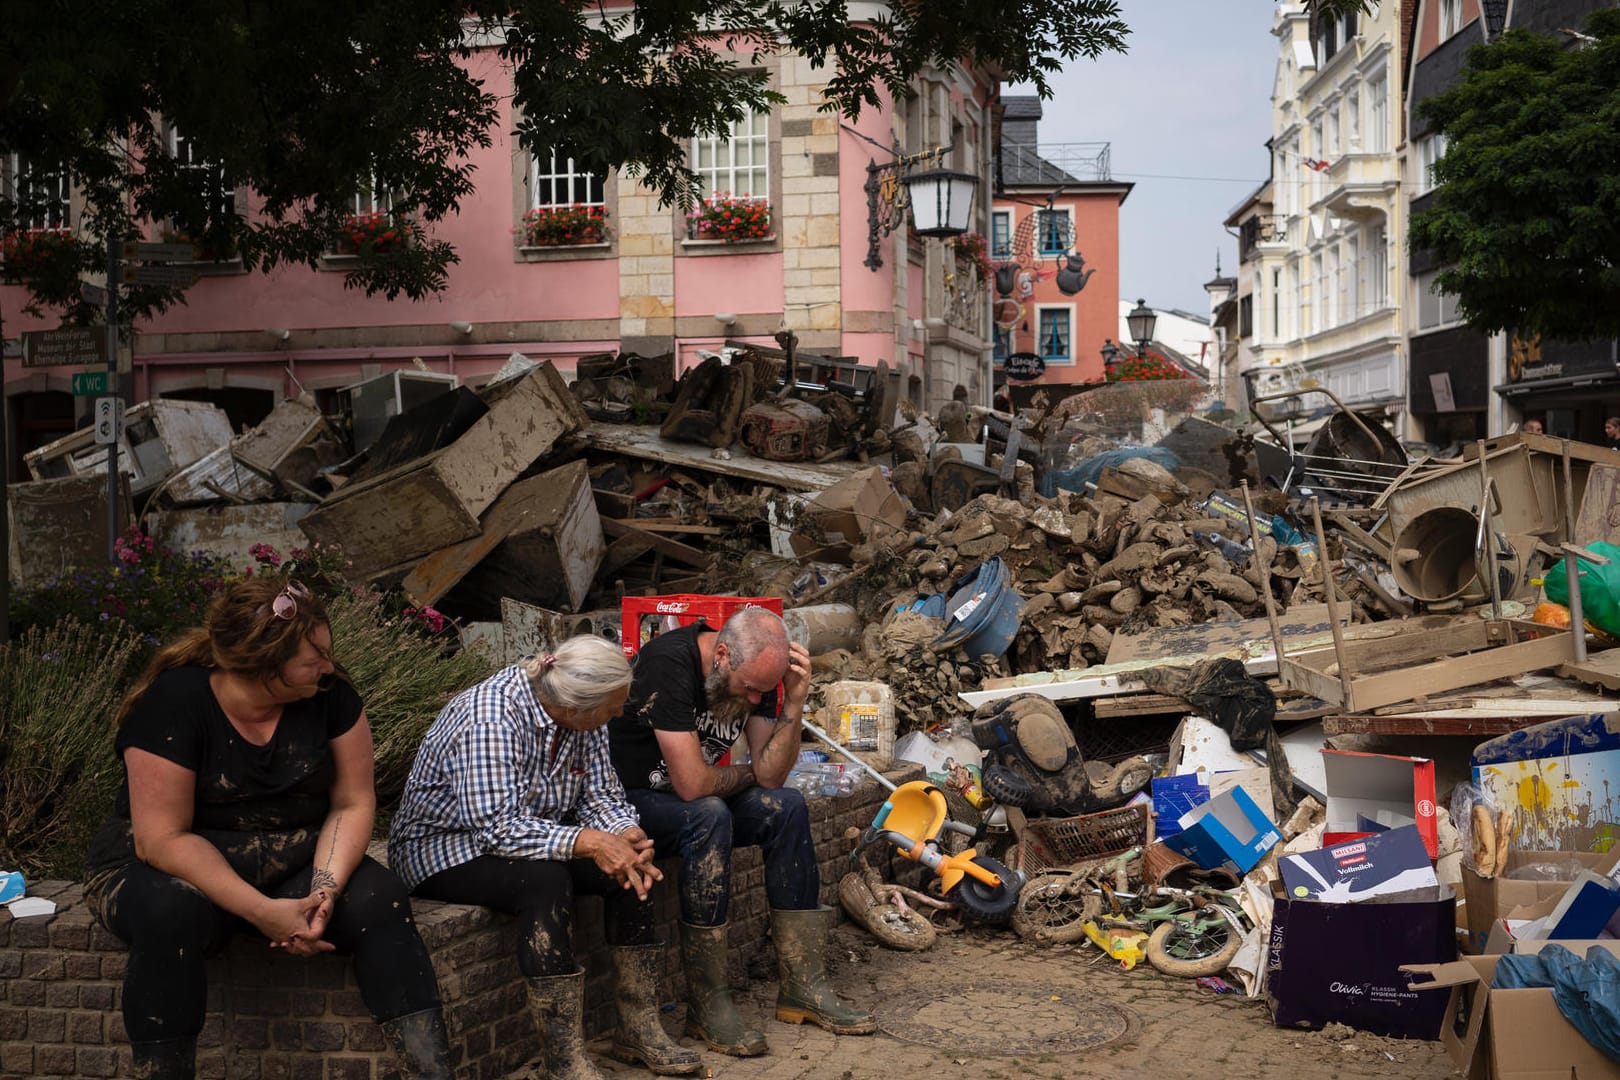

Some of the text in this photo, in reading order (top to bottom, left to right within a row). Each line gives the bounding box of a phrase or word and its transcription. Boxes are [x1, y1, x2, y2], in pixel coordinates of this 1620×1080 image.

[80, 340, 95, 351] Stadt
[85, 376, 102, 391] WC
[1336, 845, 1364, 856] MILSANI
[1337, 862, 1374, 875] Vollmilch
[1269, 924, 1285, 970] KLASSIK
[1329, 981, 1364, 995] Olivia
